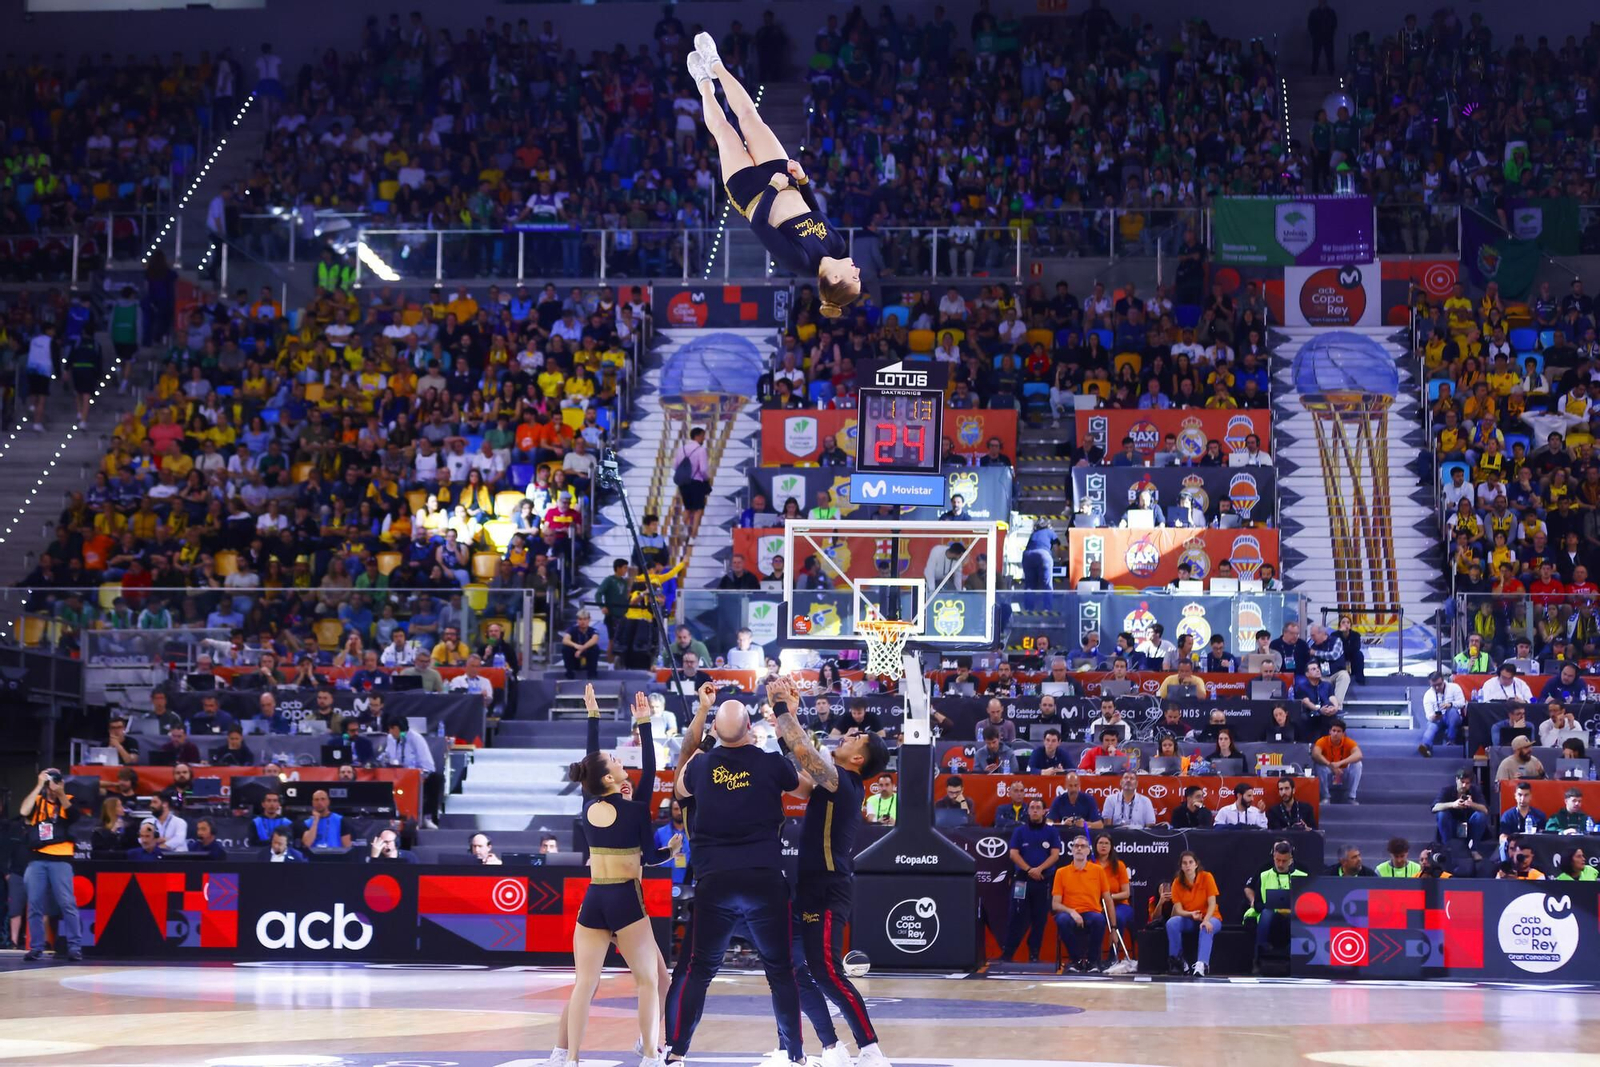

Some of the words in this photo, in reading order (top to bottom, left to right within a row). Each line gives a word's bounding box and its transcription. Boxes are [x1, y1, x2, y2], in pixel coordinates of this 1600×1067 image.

[1318, 287, 1336, 295] acb
[1311, 293, 1344, 307] Copa
[1327, 305, 1349, 317] Rey
[875, 373, 928, 387] LOTUS
[874, 423, 926, 463] 24
[892, 485, 933, 496] Movistar
[281, 701, 303, 709] acb
[281, 709, 313, 721] opa
[1182, 709, 1200, 718] NOS
[712, 765, 750, 784] Dream
[1115, 841, 1169, 854] diolanum
[895, 855, 938, 866] #CopaACB
[895, 920, 922, 930] Copa
[1520, 915, 1542, 925] acb
[256, 903, 373, 950] acb
[1511, 923, 1552, 938] Copa
[907, 929, 925, 940] Rey
[1514, 938, 1529, 946] del
[1531, 938, 1558, 953] Rey
